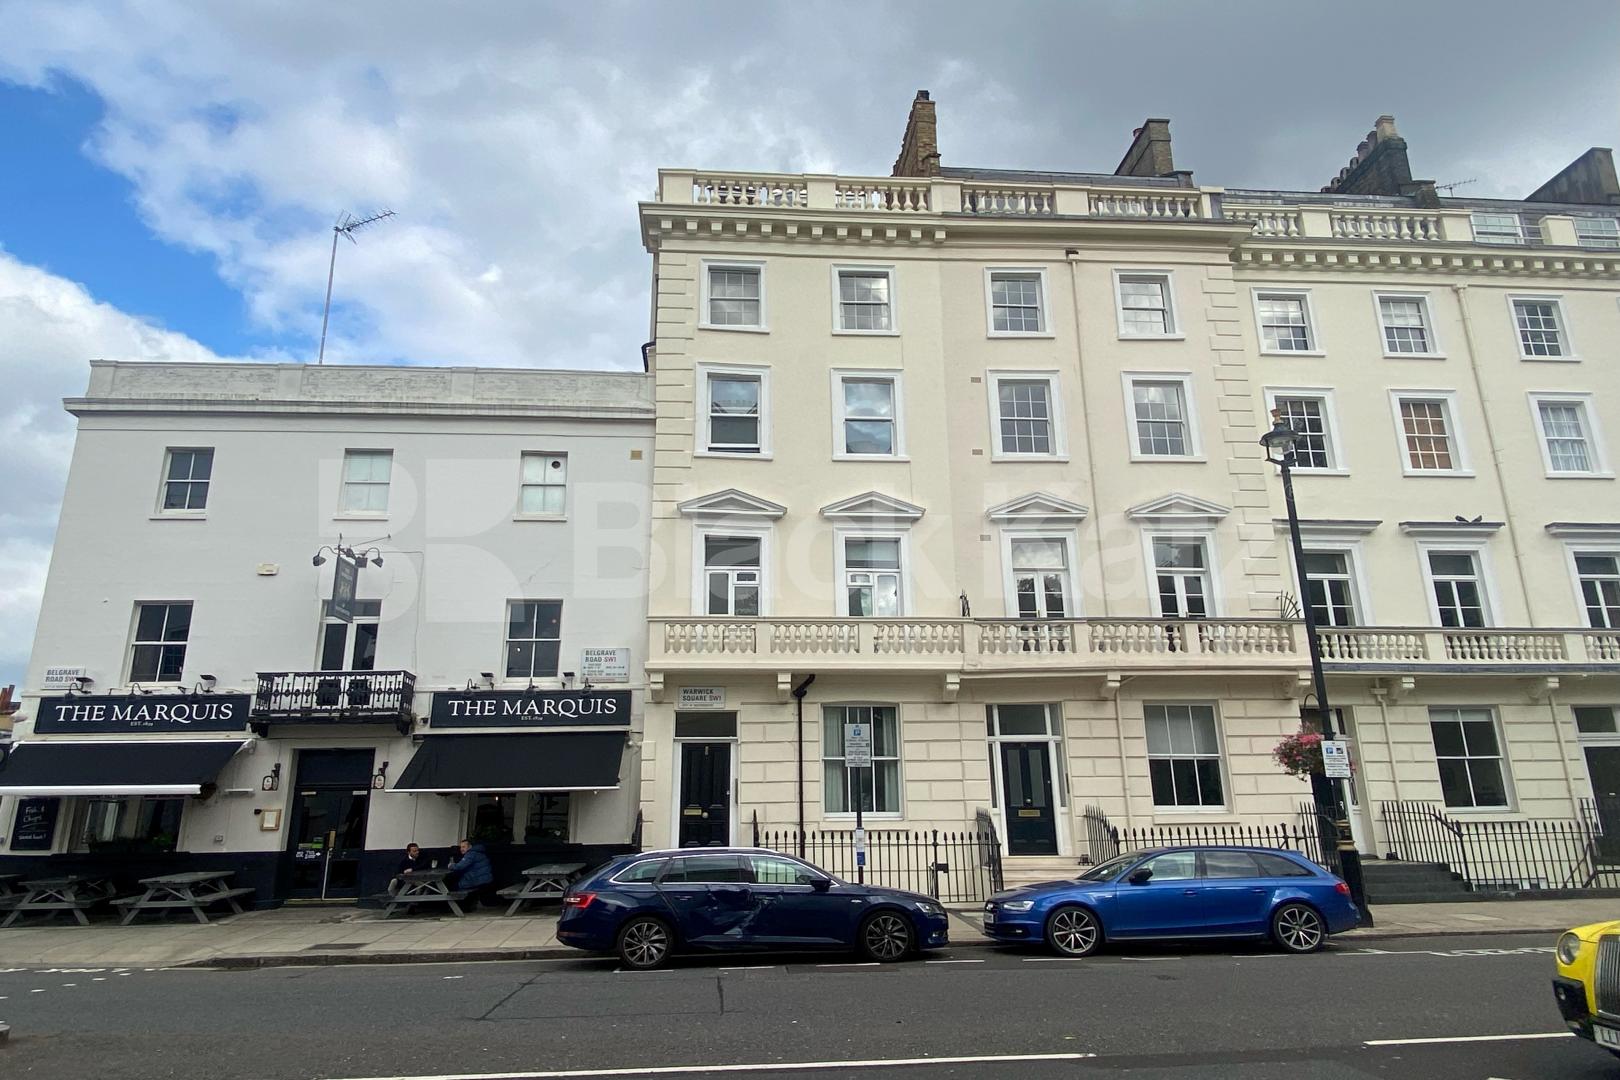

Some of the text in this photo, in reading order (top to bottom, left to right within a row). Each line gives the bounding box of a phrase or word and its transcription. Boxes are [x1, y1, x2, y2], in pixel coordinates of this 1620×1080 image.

[55, 703, 233, 723] THE MARQUIS
[448, 698, 617, 718] THE MARQUIS
